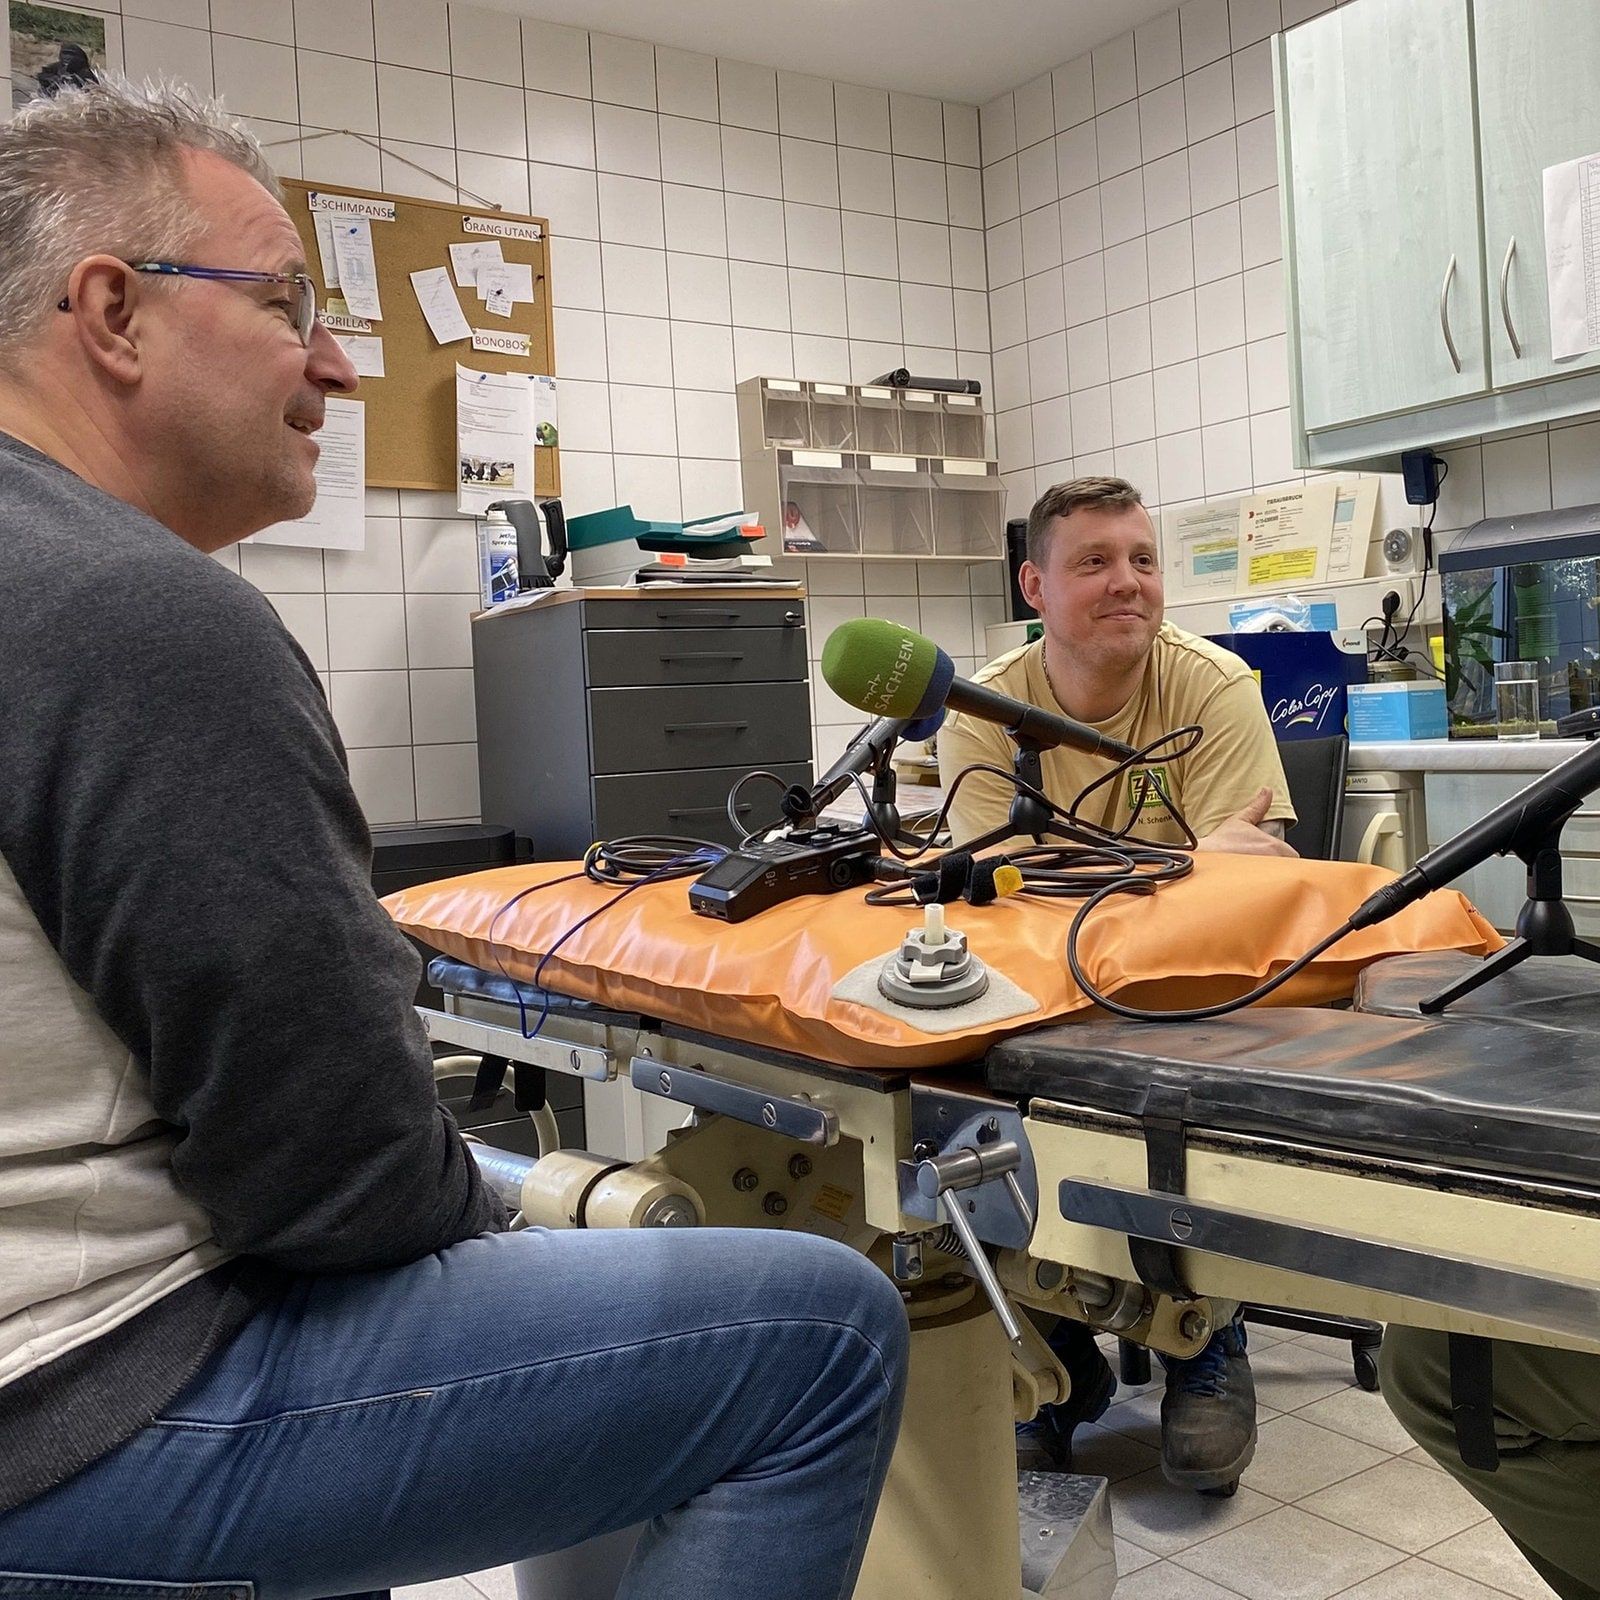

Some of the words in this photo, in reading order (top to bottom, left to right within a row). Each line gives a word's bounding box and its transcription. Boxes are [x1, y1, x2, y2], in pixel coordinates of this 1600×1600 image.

[464, 221, 502, 235] ORANG
[504, 227, 539, 240] UTANS
[319, 314, 371, 330] GORILLAS
[475, 336, 526, 350] BONOBOS
[874, 639, 914, 711] SACHSEN
[1271, 698, 1303, 723] Color
[1304, 684, 1338, 731] Copy
